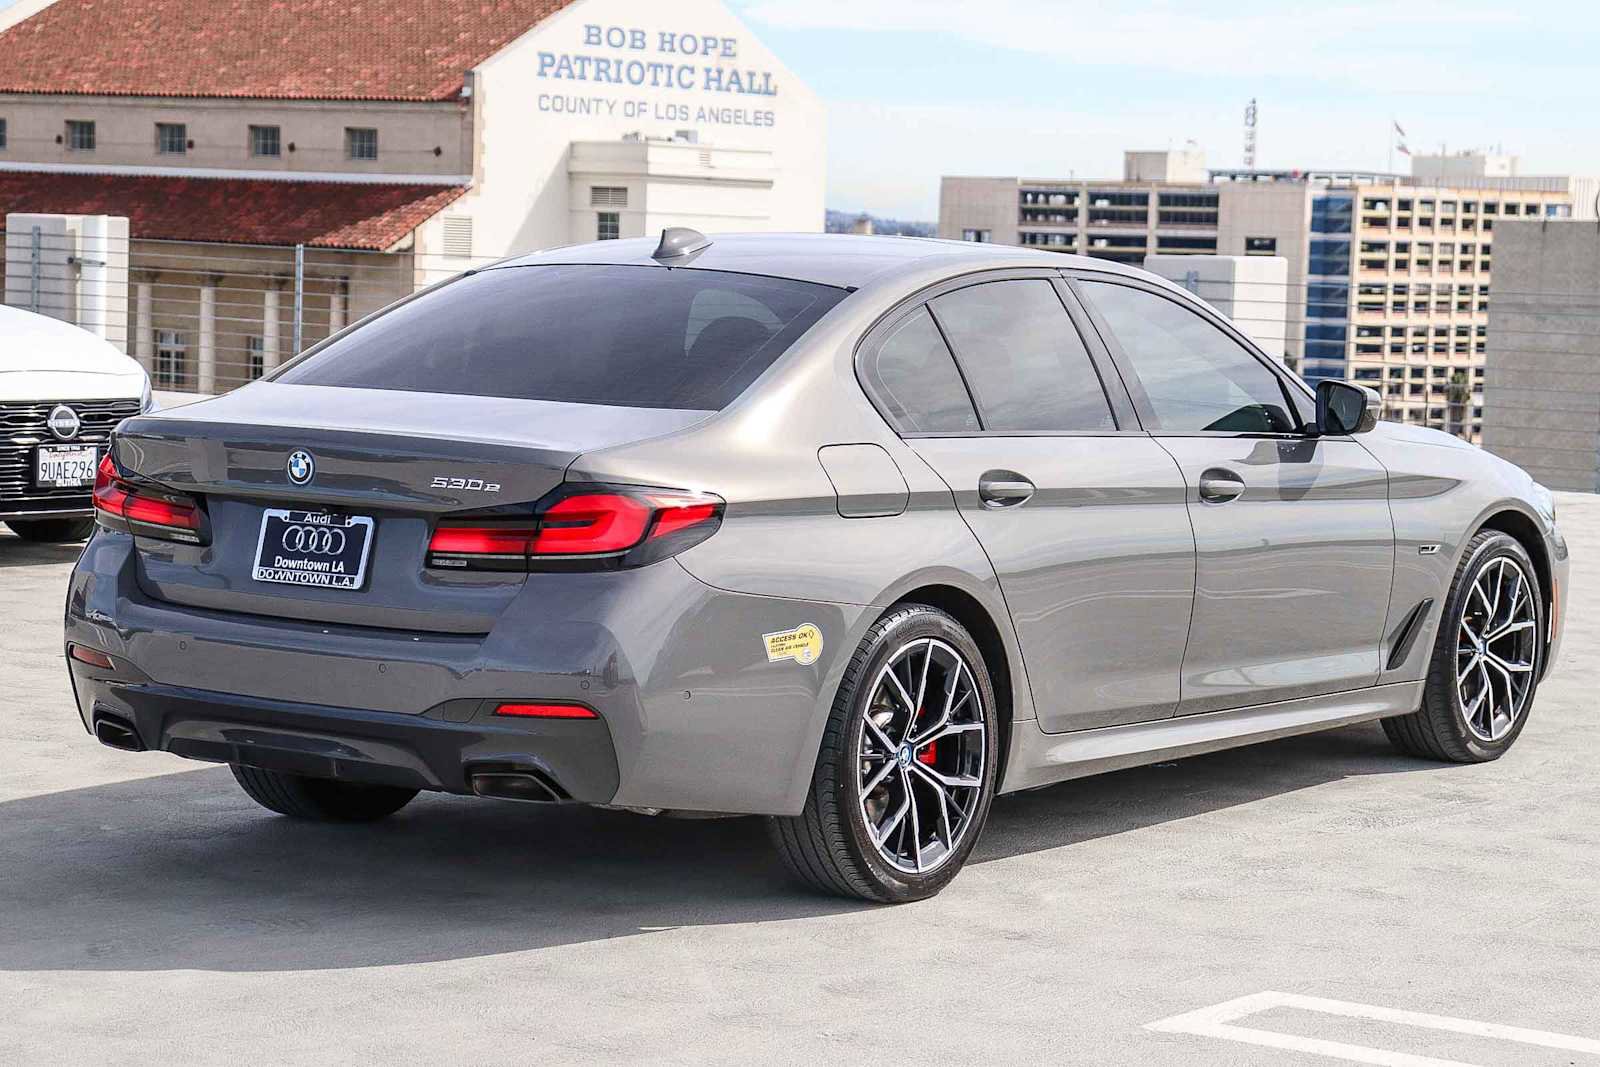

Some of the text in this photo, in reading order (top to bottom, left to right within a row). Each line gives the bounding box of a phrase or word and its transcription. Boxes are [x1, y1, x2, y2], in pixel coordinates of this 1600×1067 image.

[583, 24, 737, 58] BOB HOPE
[537, 51, 778, 96] PATRIOTIC HALL
[538, 94, 775, 127] COUNTY OF LOS ANGELES
[41, 460, 93, 480] 9UAE296
[304, 513, 331, 524] Audi
[274, 555, 345, 573] Downtown LA
[258, 568, 353, 587] DOWNTOWN L.A.
